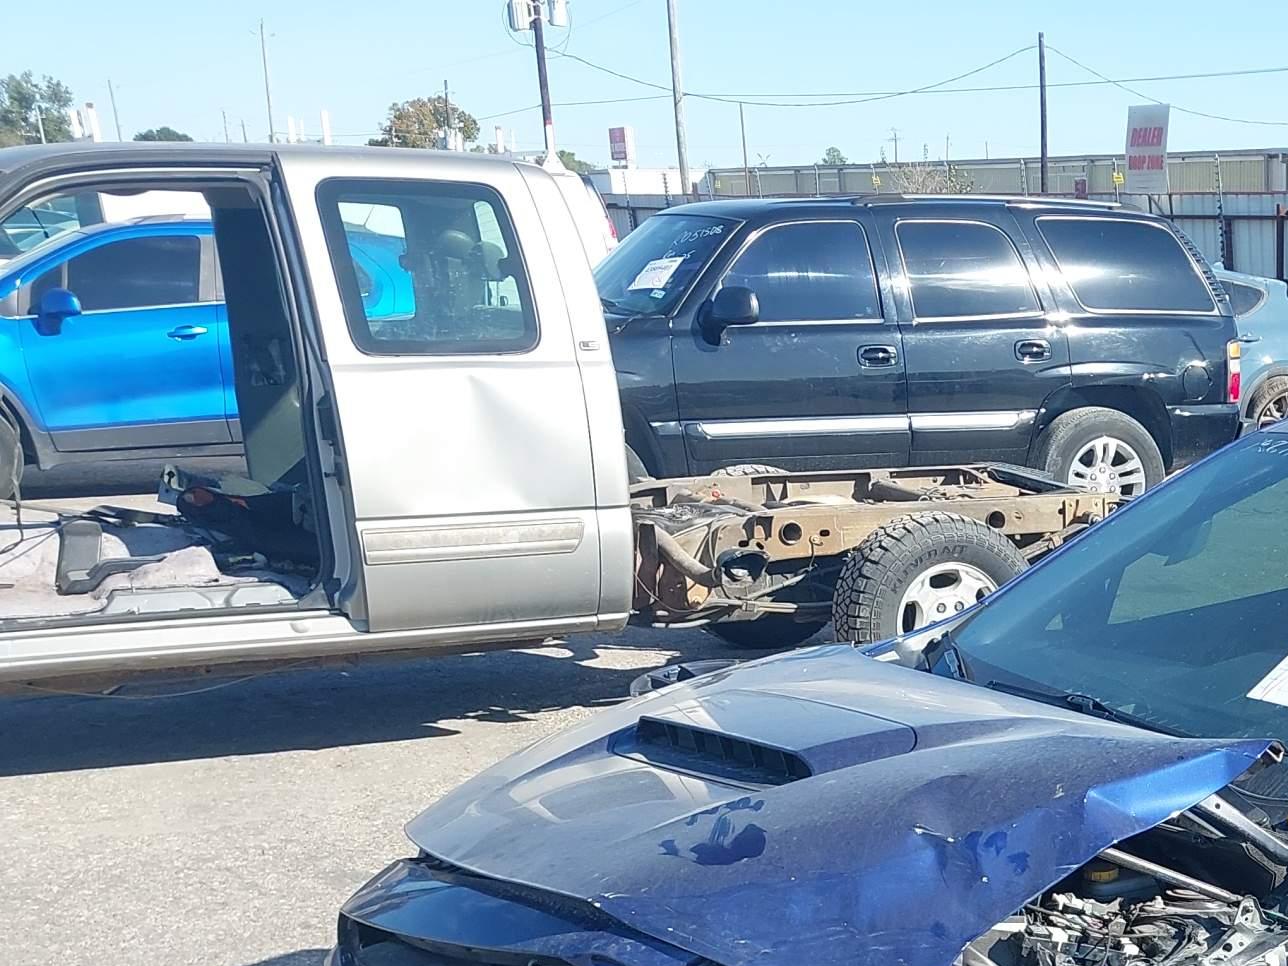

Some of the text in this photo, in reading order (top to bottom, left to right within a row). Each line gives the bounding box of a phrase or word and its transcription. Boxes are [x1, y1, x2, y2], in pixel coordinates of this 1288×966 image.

[1130, 127, 1164, 147] DEALER
[1128, 155, 1164, 170] DROP ZONE
